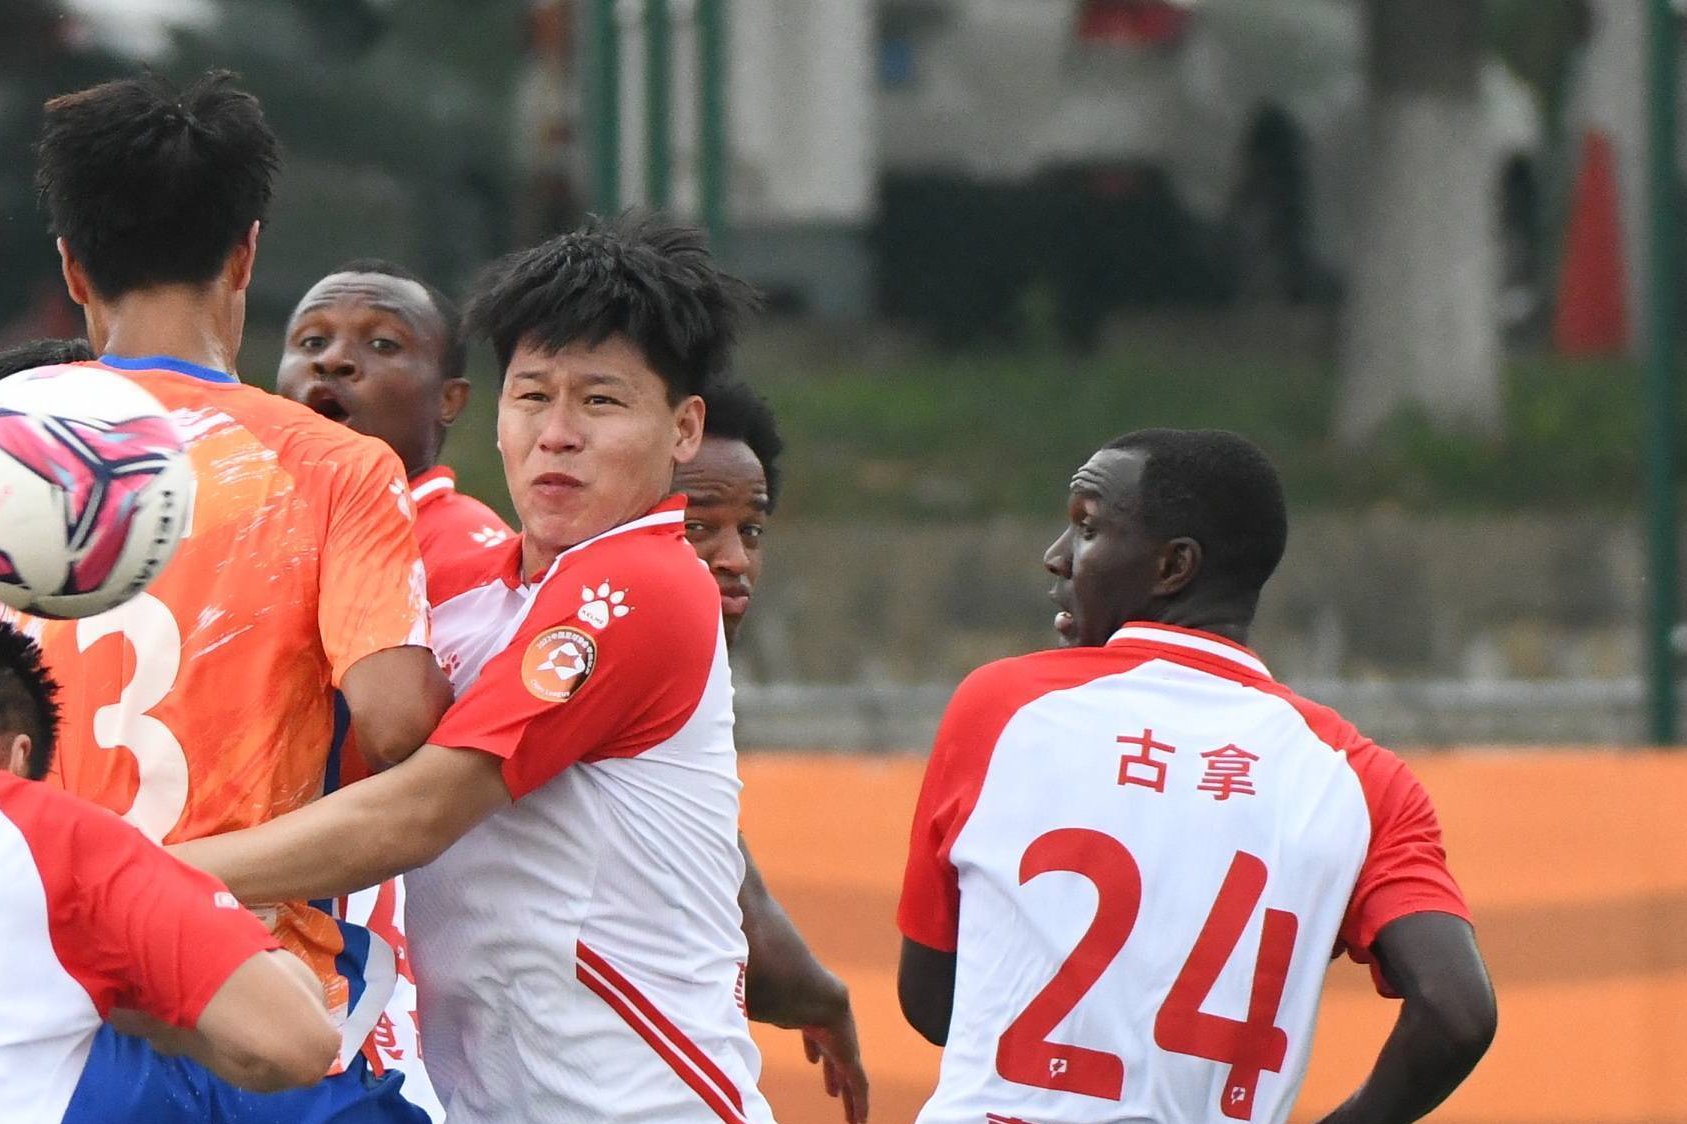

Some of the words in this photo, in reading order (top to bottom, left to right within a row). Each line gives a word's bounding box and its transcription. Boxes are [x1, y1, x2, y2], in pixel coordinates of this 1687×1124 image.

[76, 591, 189, 846] 3
[1116, 729, 1260, 801] 古拿
[996, 827, 1299, 1121] 24
